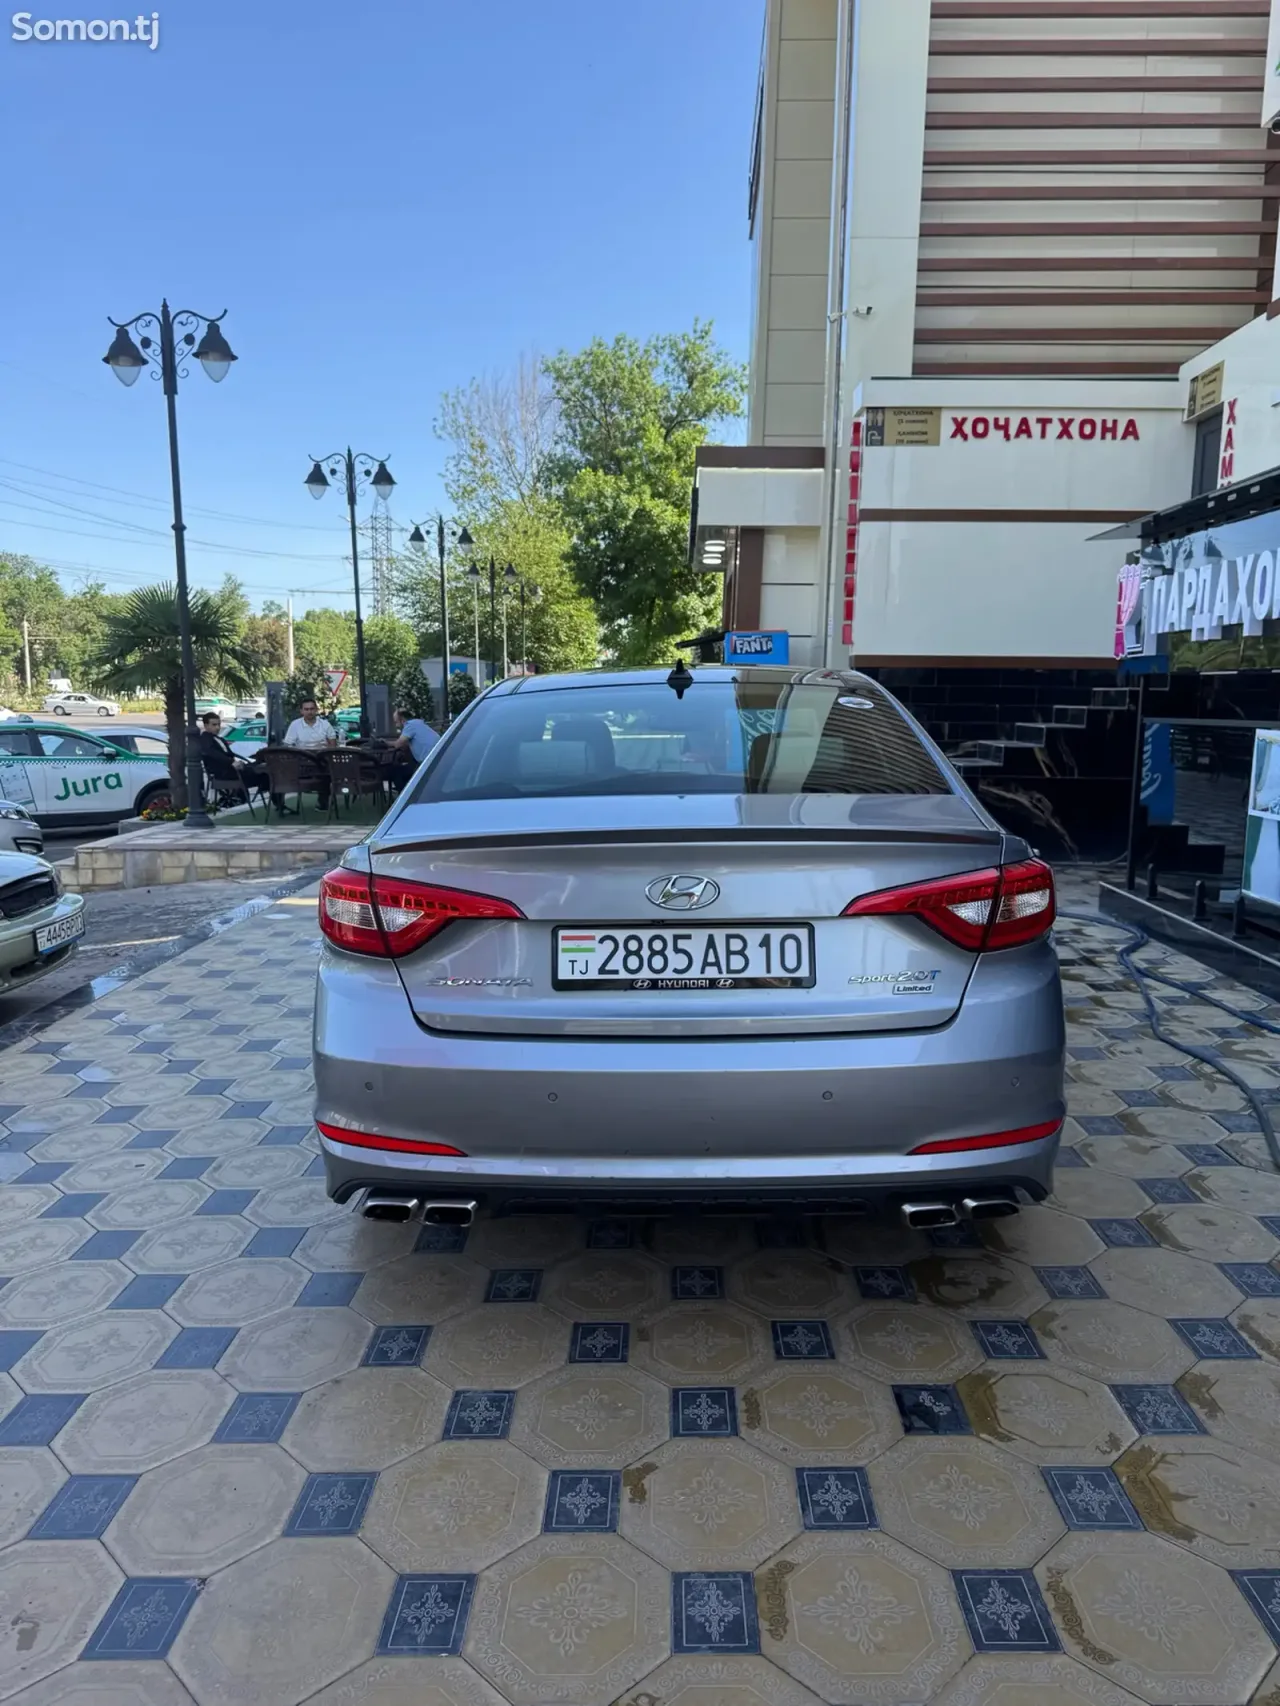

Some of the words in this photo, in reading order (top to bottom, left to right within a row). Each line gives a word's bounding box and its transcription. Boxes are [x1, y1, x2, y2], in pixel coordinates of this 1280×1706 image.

[735, 636, 773, 654] FANTA
[54, 772, 123, 801] Jura
[568, 959, 589, 975] TJ
[426, 976, 534, 987] SONATA
[658, 979, 709, 988] HYUNDAI
